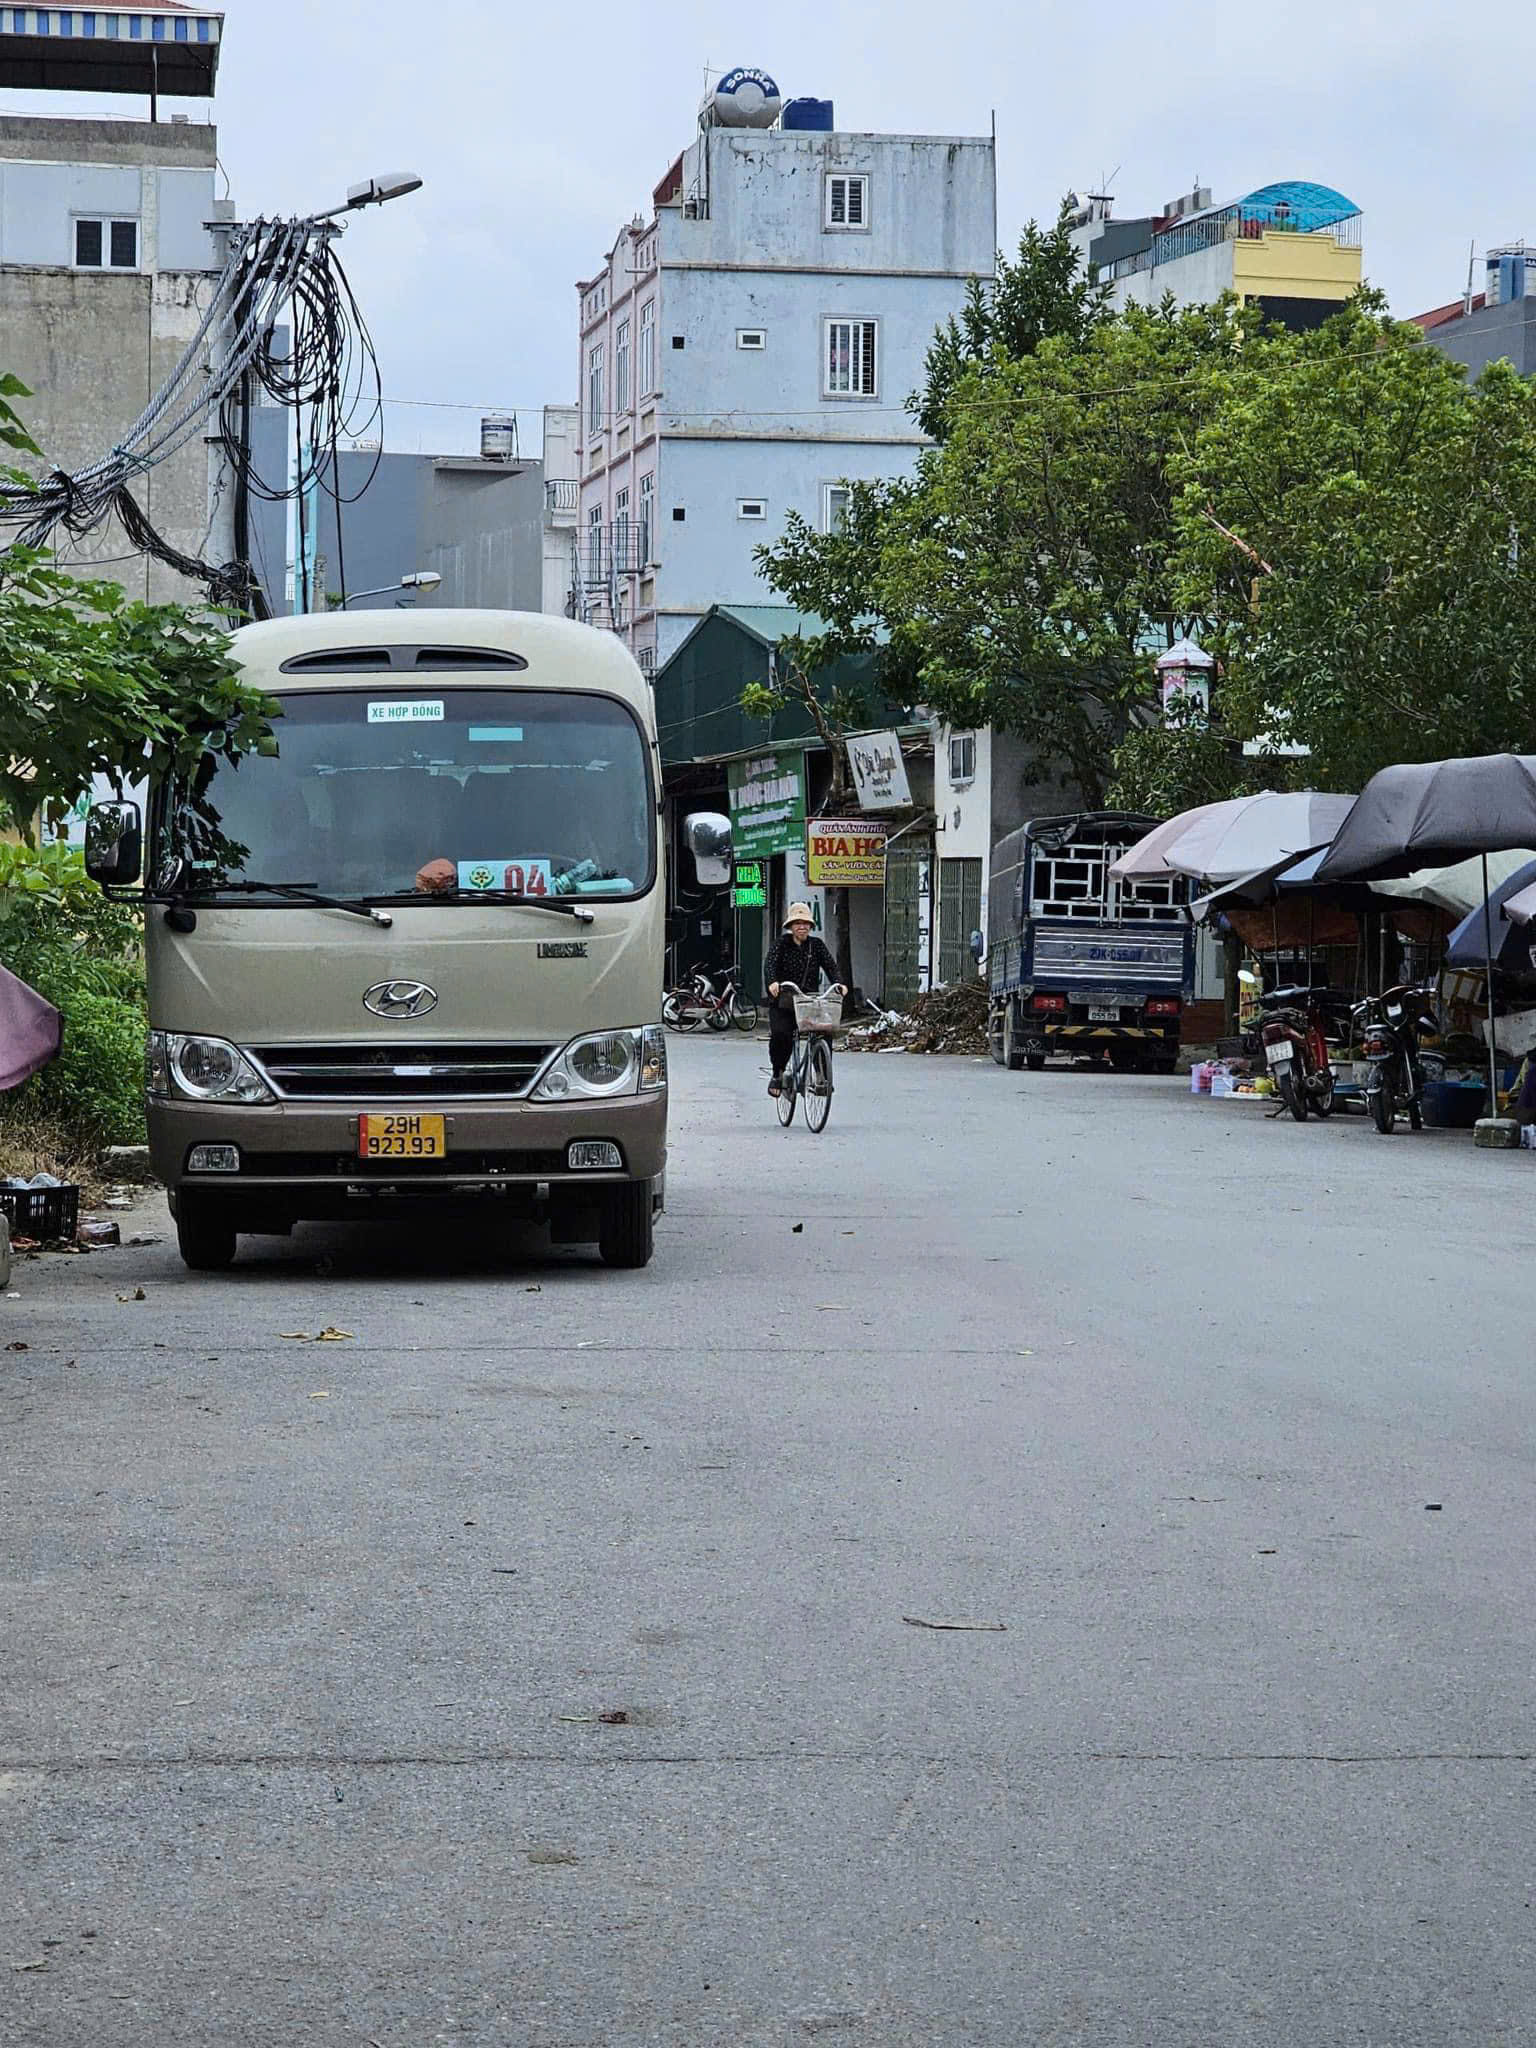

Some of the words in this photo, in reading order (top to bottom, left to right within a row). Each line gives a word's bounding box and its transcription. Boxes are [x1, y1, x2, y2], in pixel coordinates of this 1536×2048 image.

[372, 707, 385, 718] XE
[388, 706, 409, 720] HỢP
[812, 837, 851, 857] BIA
[504, 864, 547, 896] 04
[736, 863, 761, 882] NHÀ
[735, 882, 765, 905] THUỐC
[383, 1116, 421, 1135] 29H
[368, 1137, 436, 1155] 923.93
